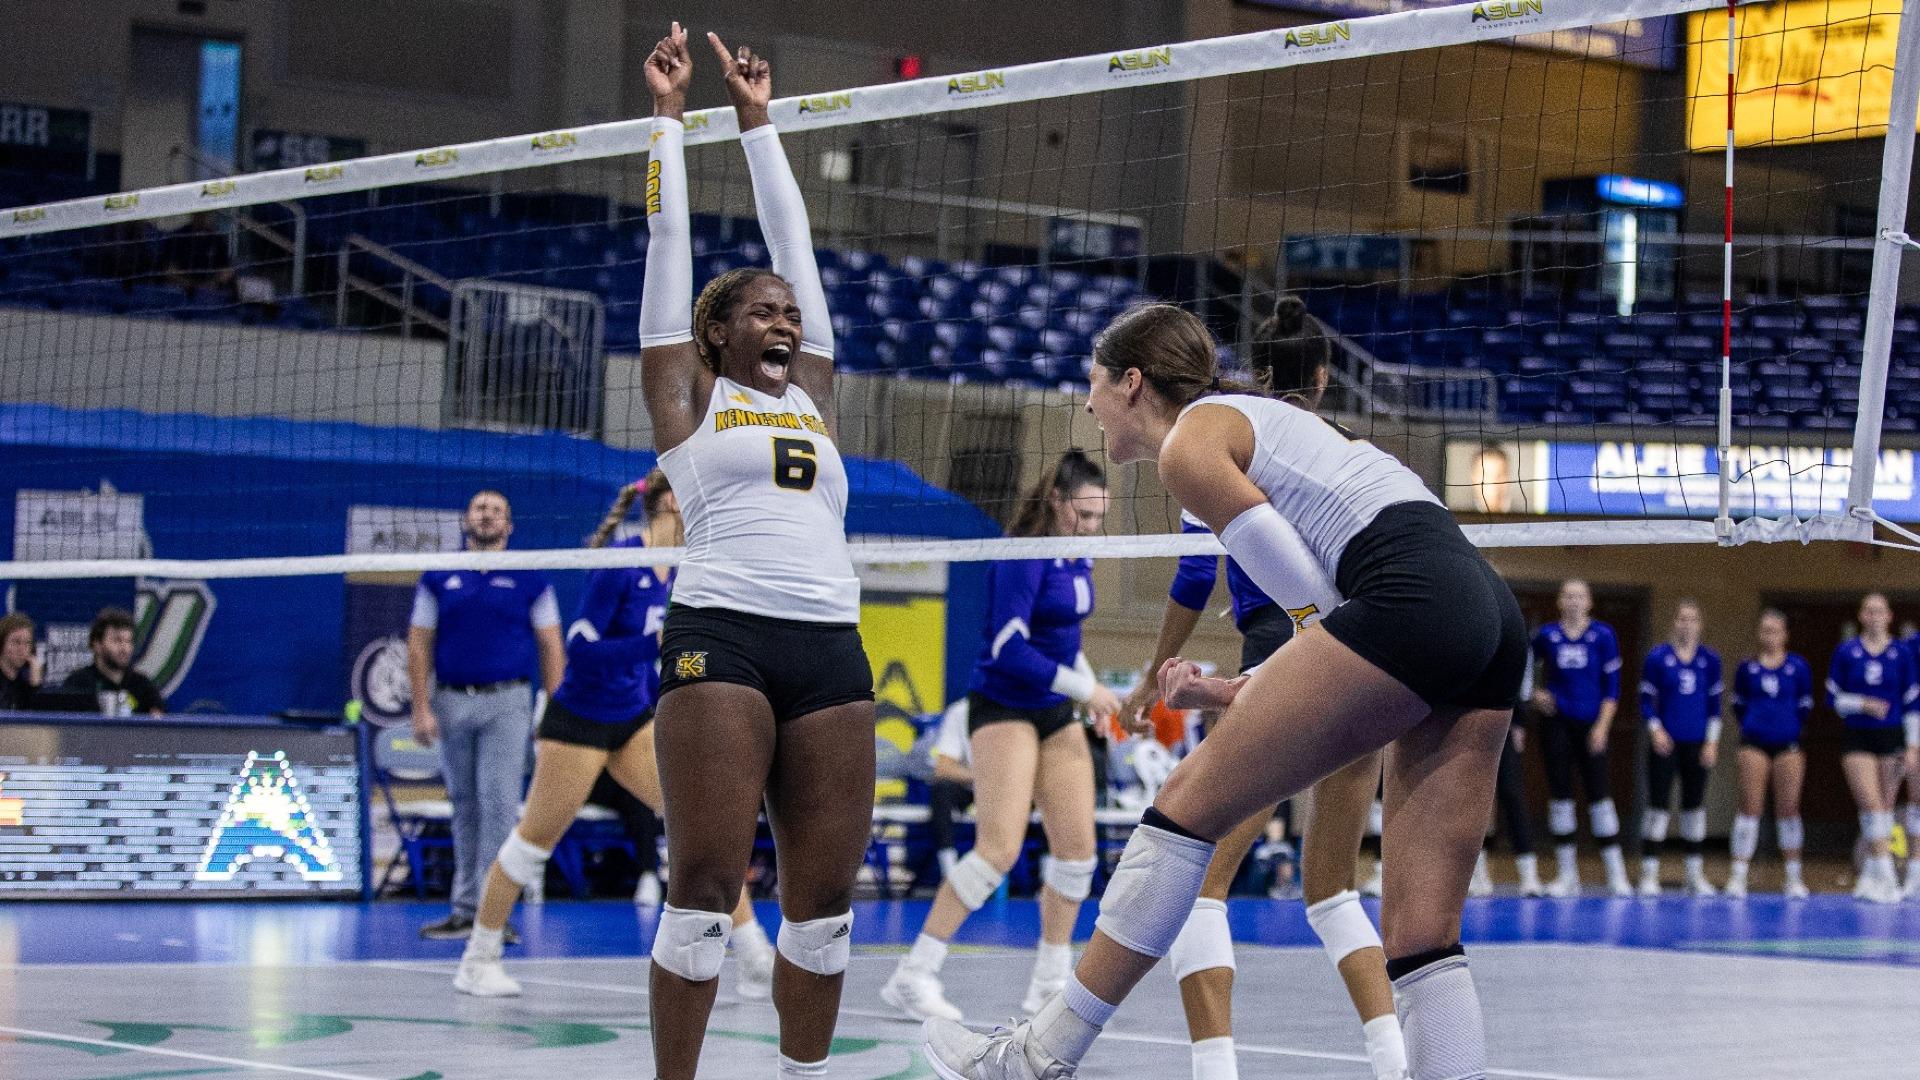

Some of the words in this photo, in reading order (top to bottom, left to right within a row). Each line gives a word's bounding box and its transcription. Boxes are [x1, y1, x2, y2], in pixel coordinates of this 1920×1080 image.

[1472, 0, 1543, 23] ASUN
[1284, 21, 1351, 49] ASUN
[1108, 47, 1171, 73] ASUN
[948, 70, 1005, 95] ASUN
[799, 93, 852, 114] ASUN
[531, 132, 577, 151] ASUN
[415, 148, 459, 168] ASUN
[714, 408, 802, 433] KENNESAW
[770, 436, 817, 491] 6
